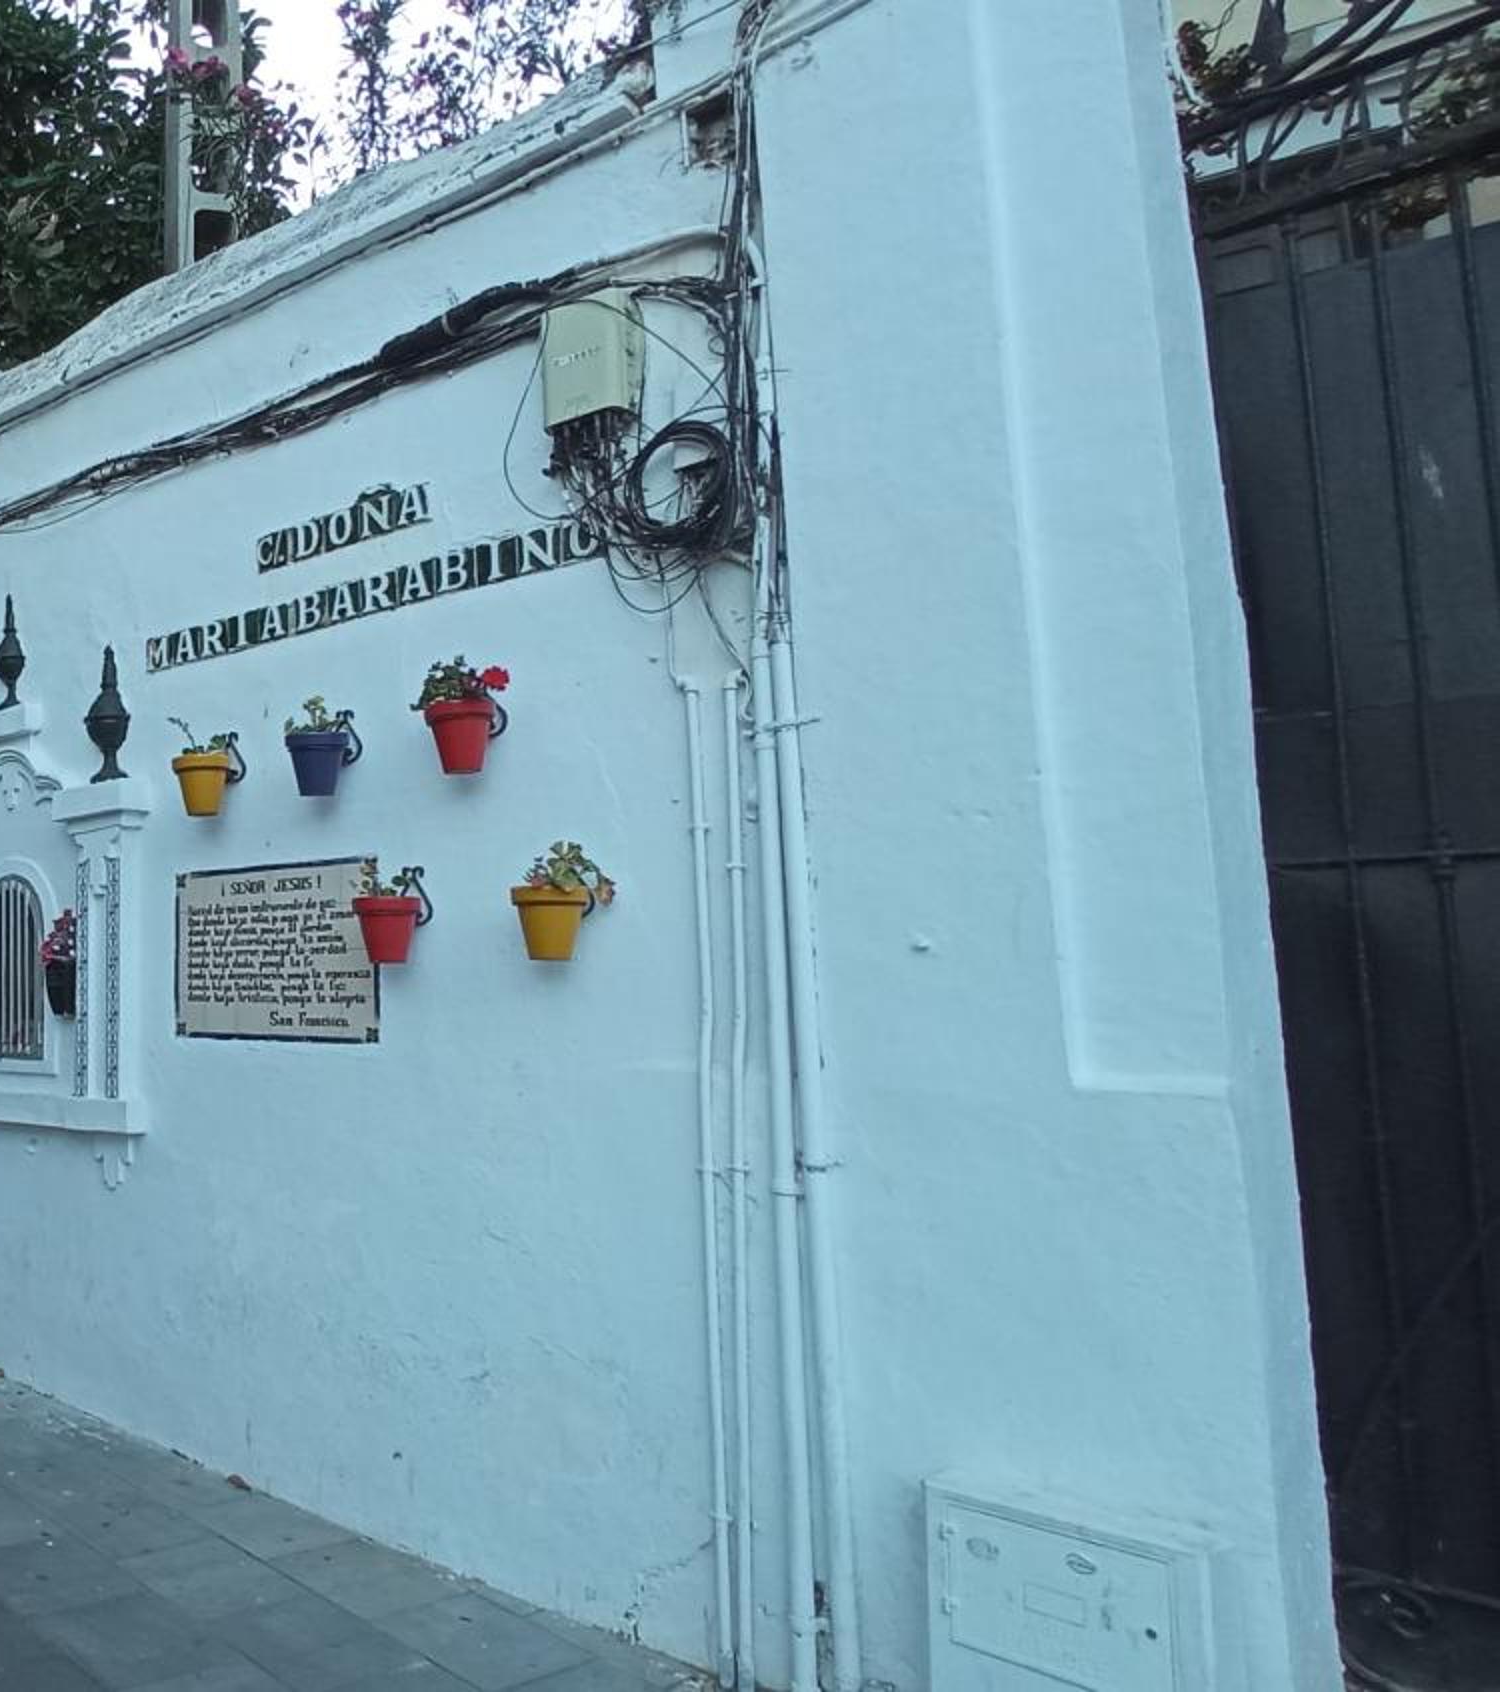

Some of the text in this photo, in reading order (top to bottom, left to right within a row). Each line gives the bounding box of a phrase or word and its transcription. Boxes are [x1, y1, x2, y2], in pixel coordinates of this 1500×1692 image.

[296, 482, 432, 560] DOÑA
[146, 518, 602, 672] MARIA BARABINO
